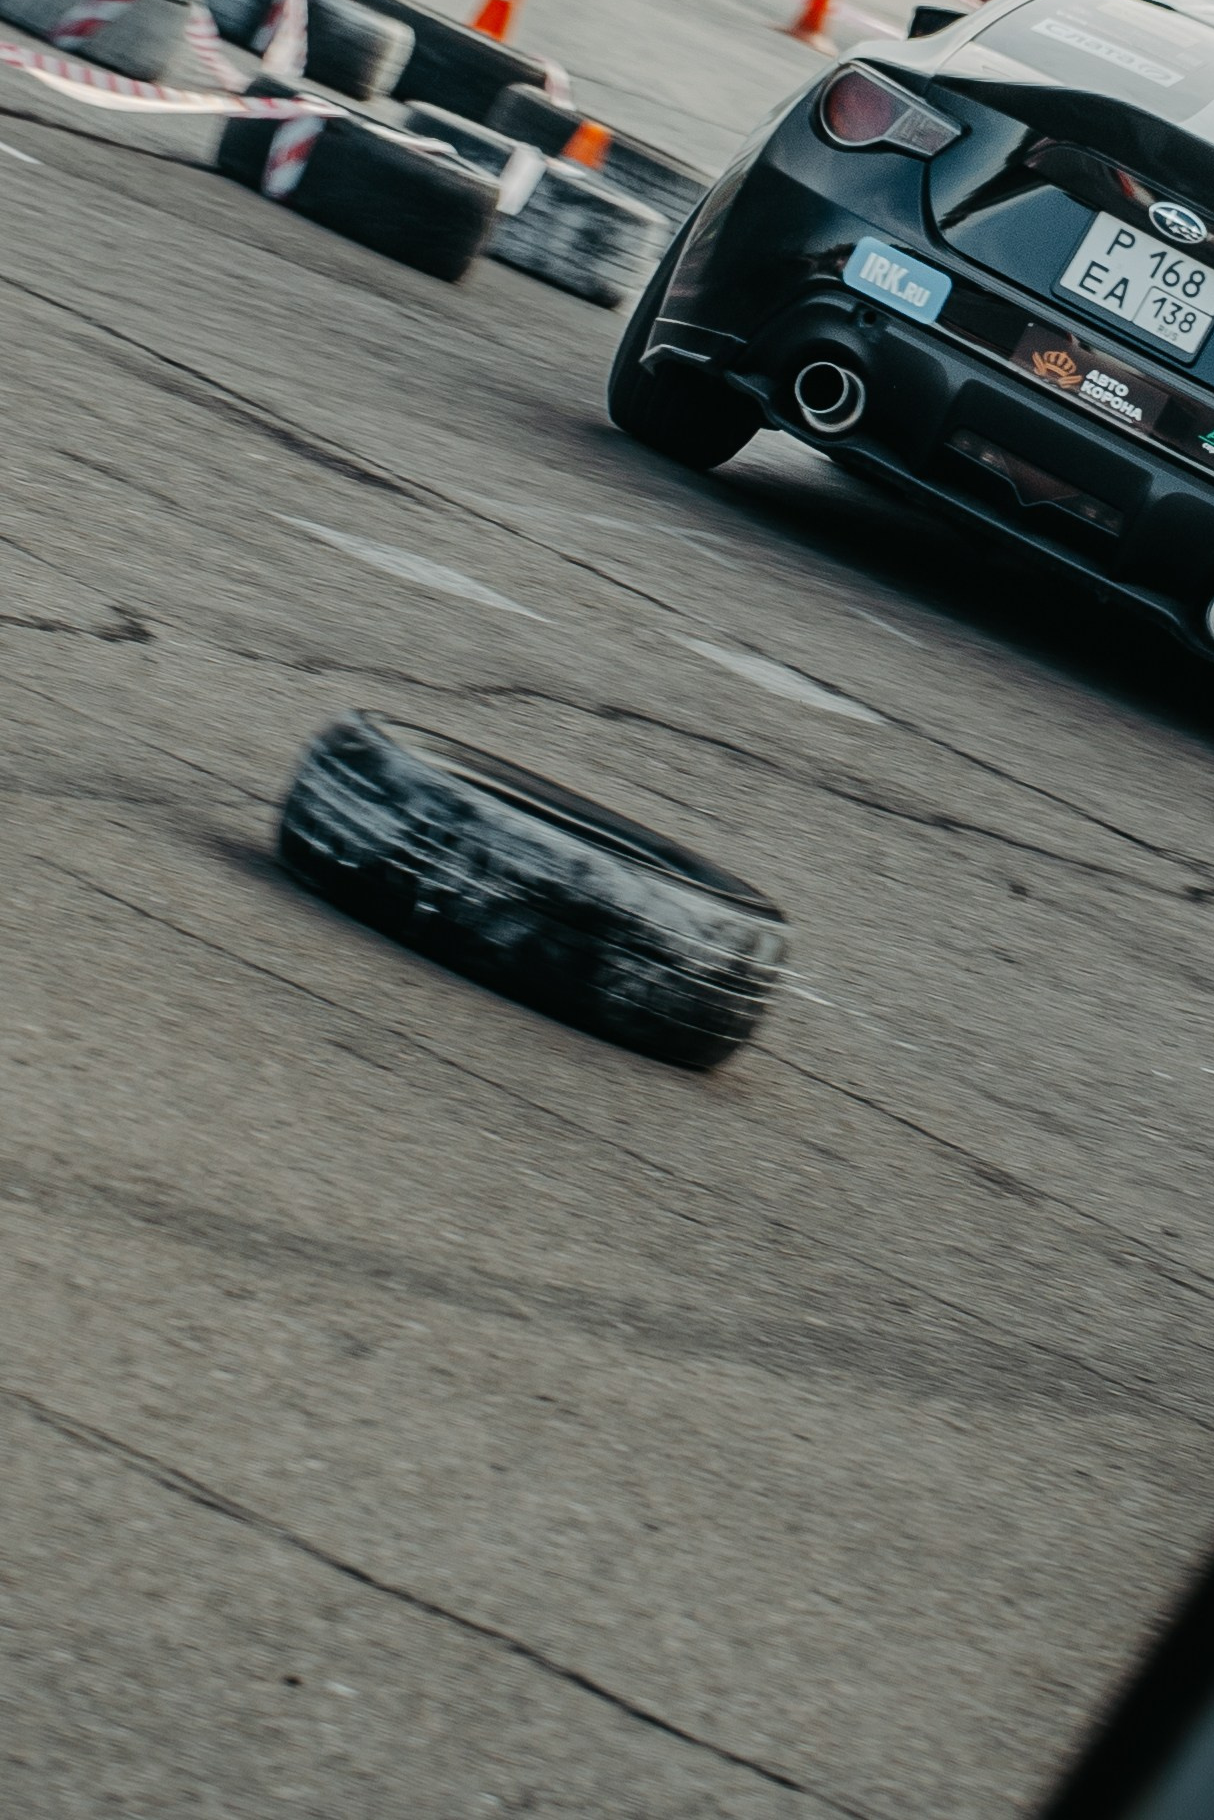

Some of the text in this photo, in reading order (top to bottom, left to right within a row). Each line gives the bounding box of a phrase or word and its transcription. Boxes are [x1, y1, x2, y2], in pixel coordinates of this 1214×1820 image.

[1149, 251, 1206, 298] 168
[1152, 297, 1197, 333] 138
[1081, 380, 1142, 421] КОРОНА
[1085, 369, 1129, 397] АВТО
